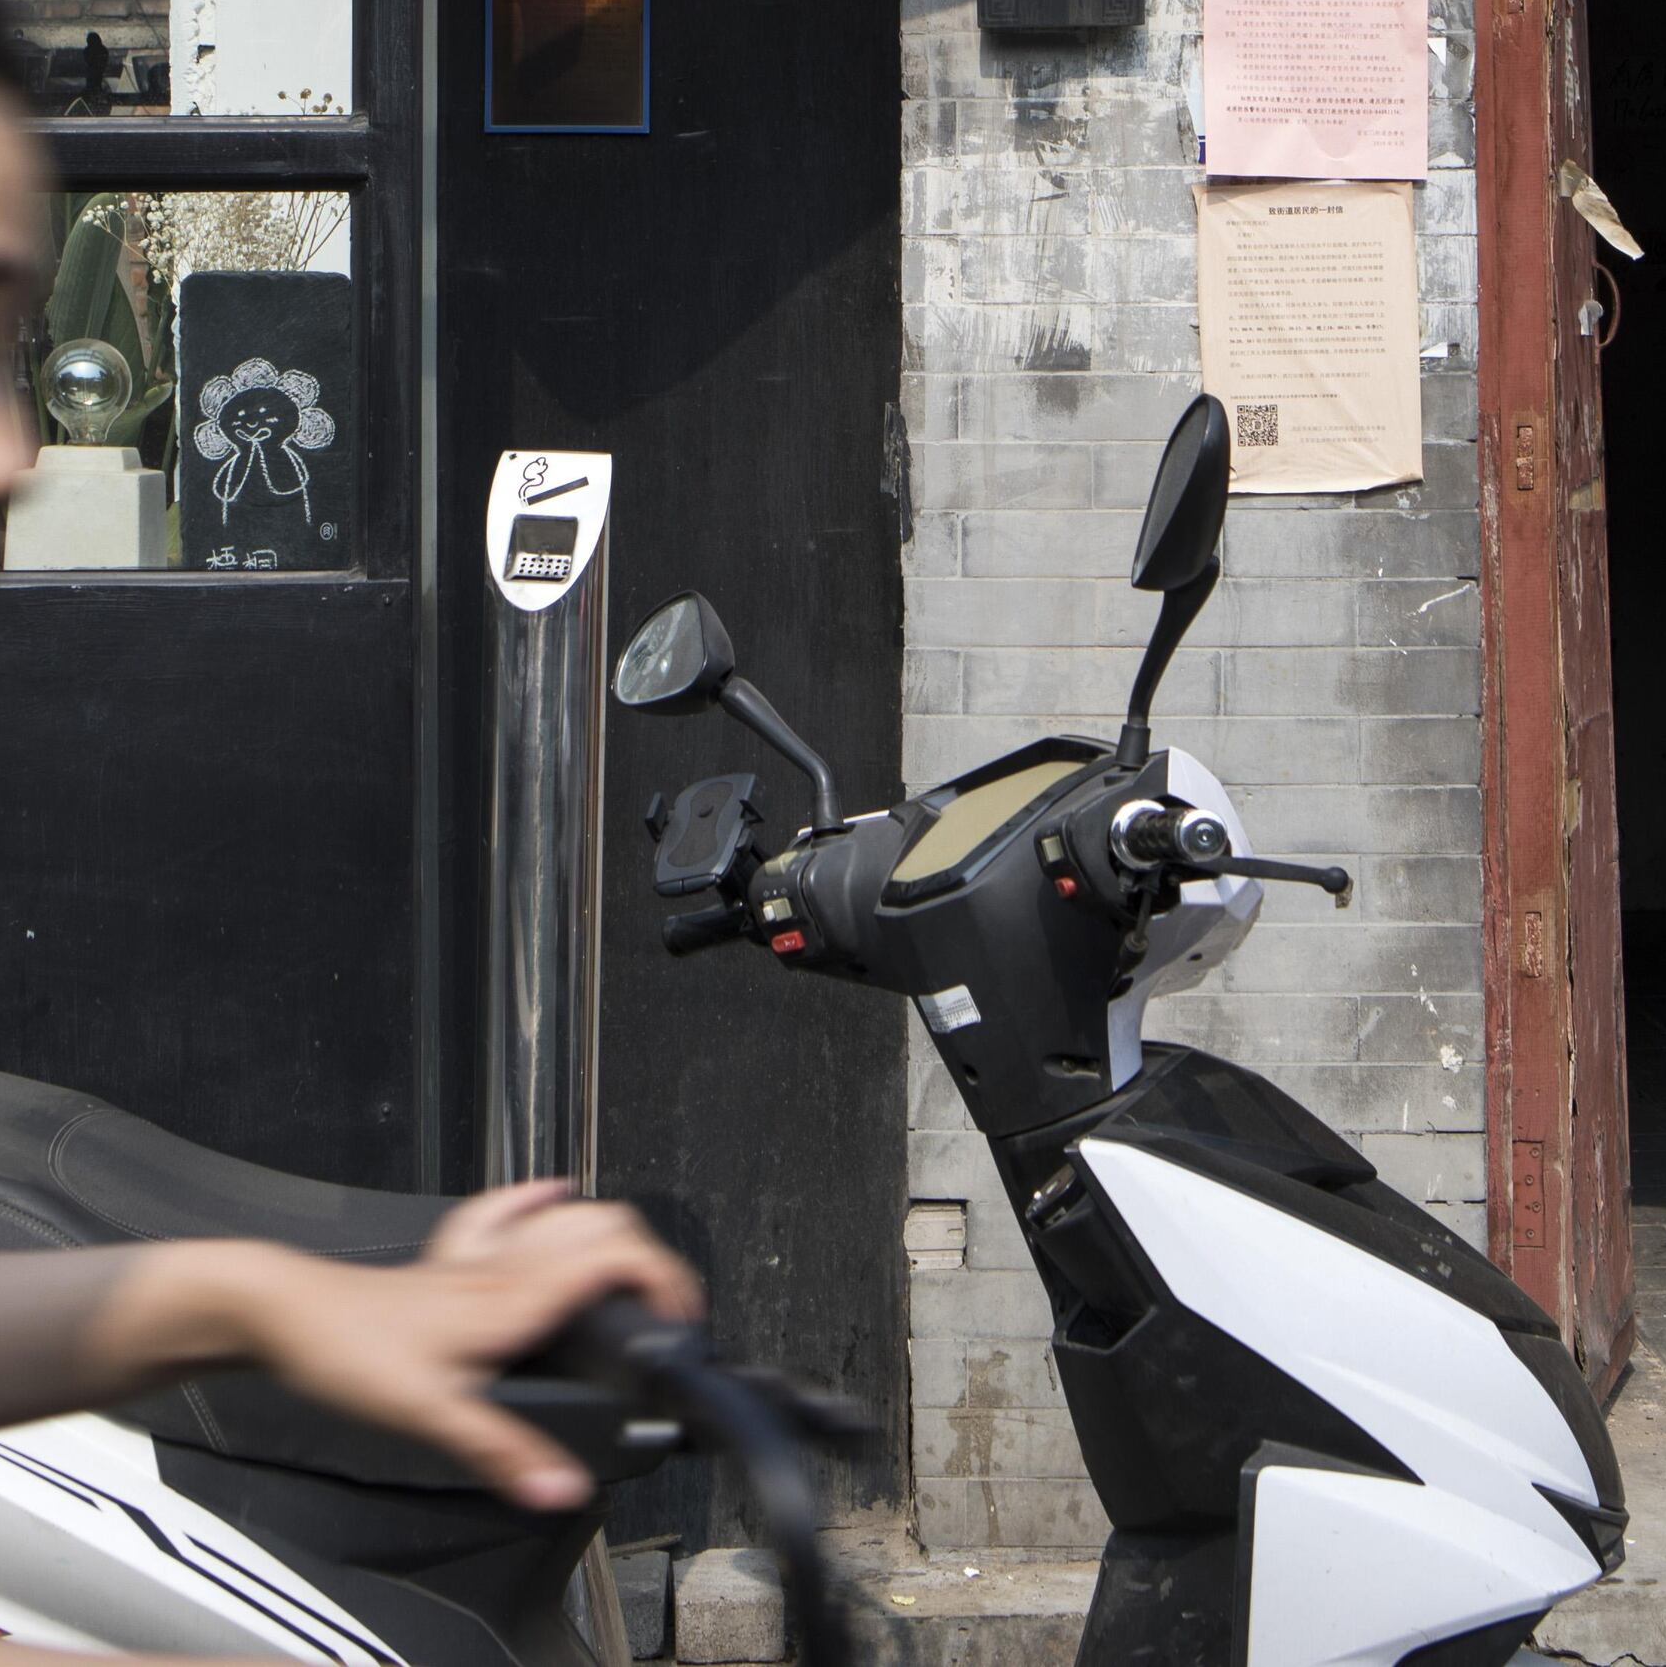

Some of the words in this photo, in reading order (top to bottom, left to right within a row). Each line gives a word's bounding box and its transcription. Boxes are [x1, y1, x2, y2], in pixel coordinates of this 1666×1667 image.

[1268, 205, 1344, 215] 致街道居民的一封信
